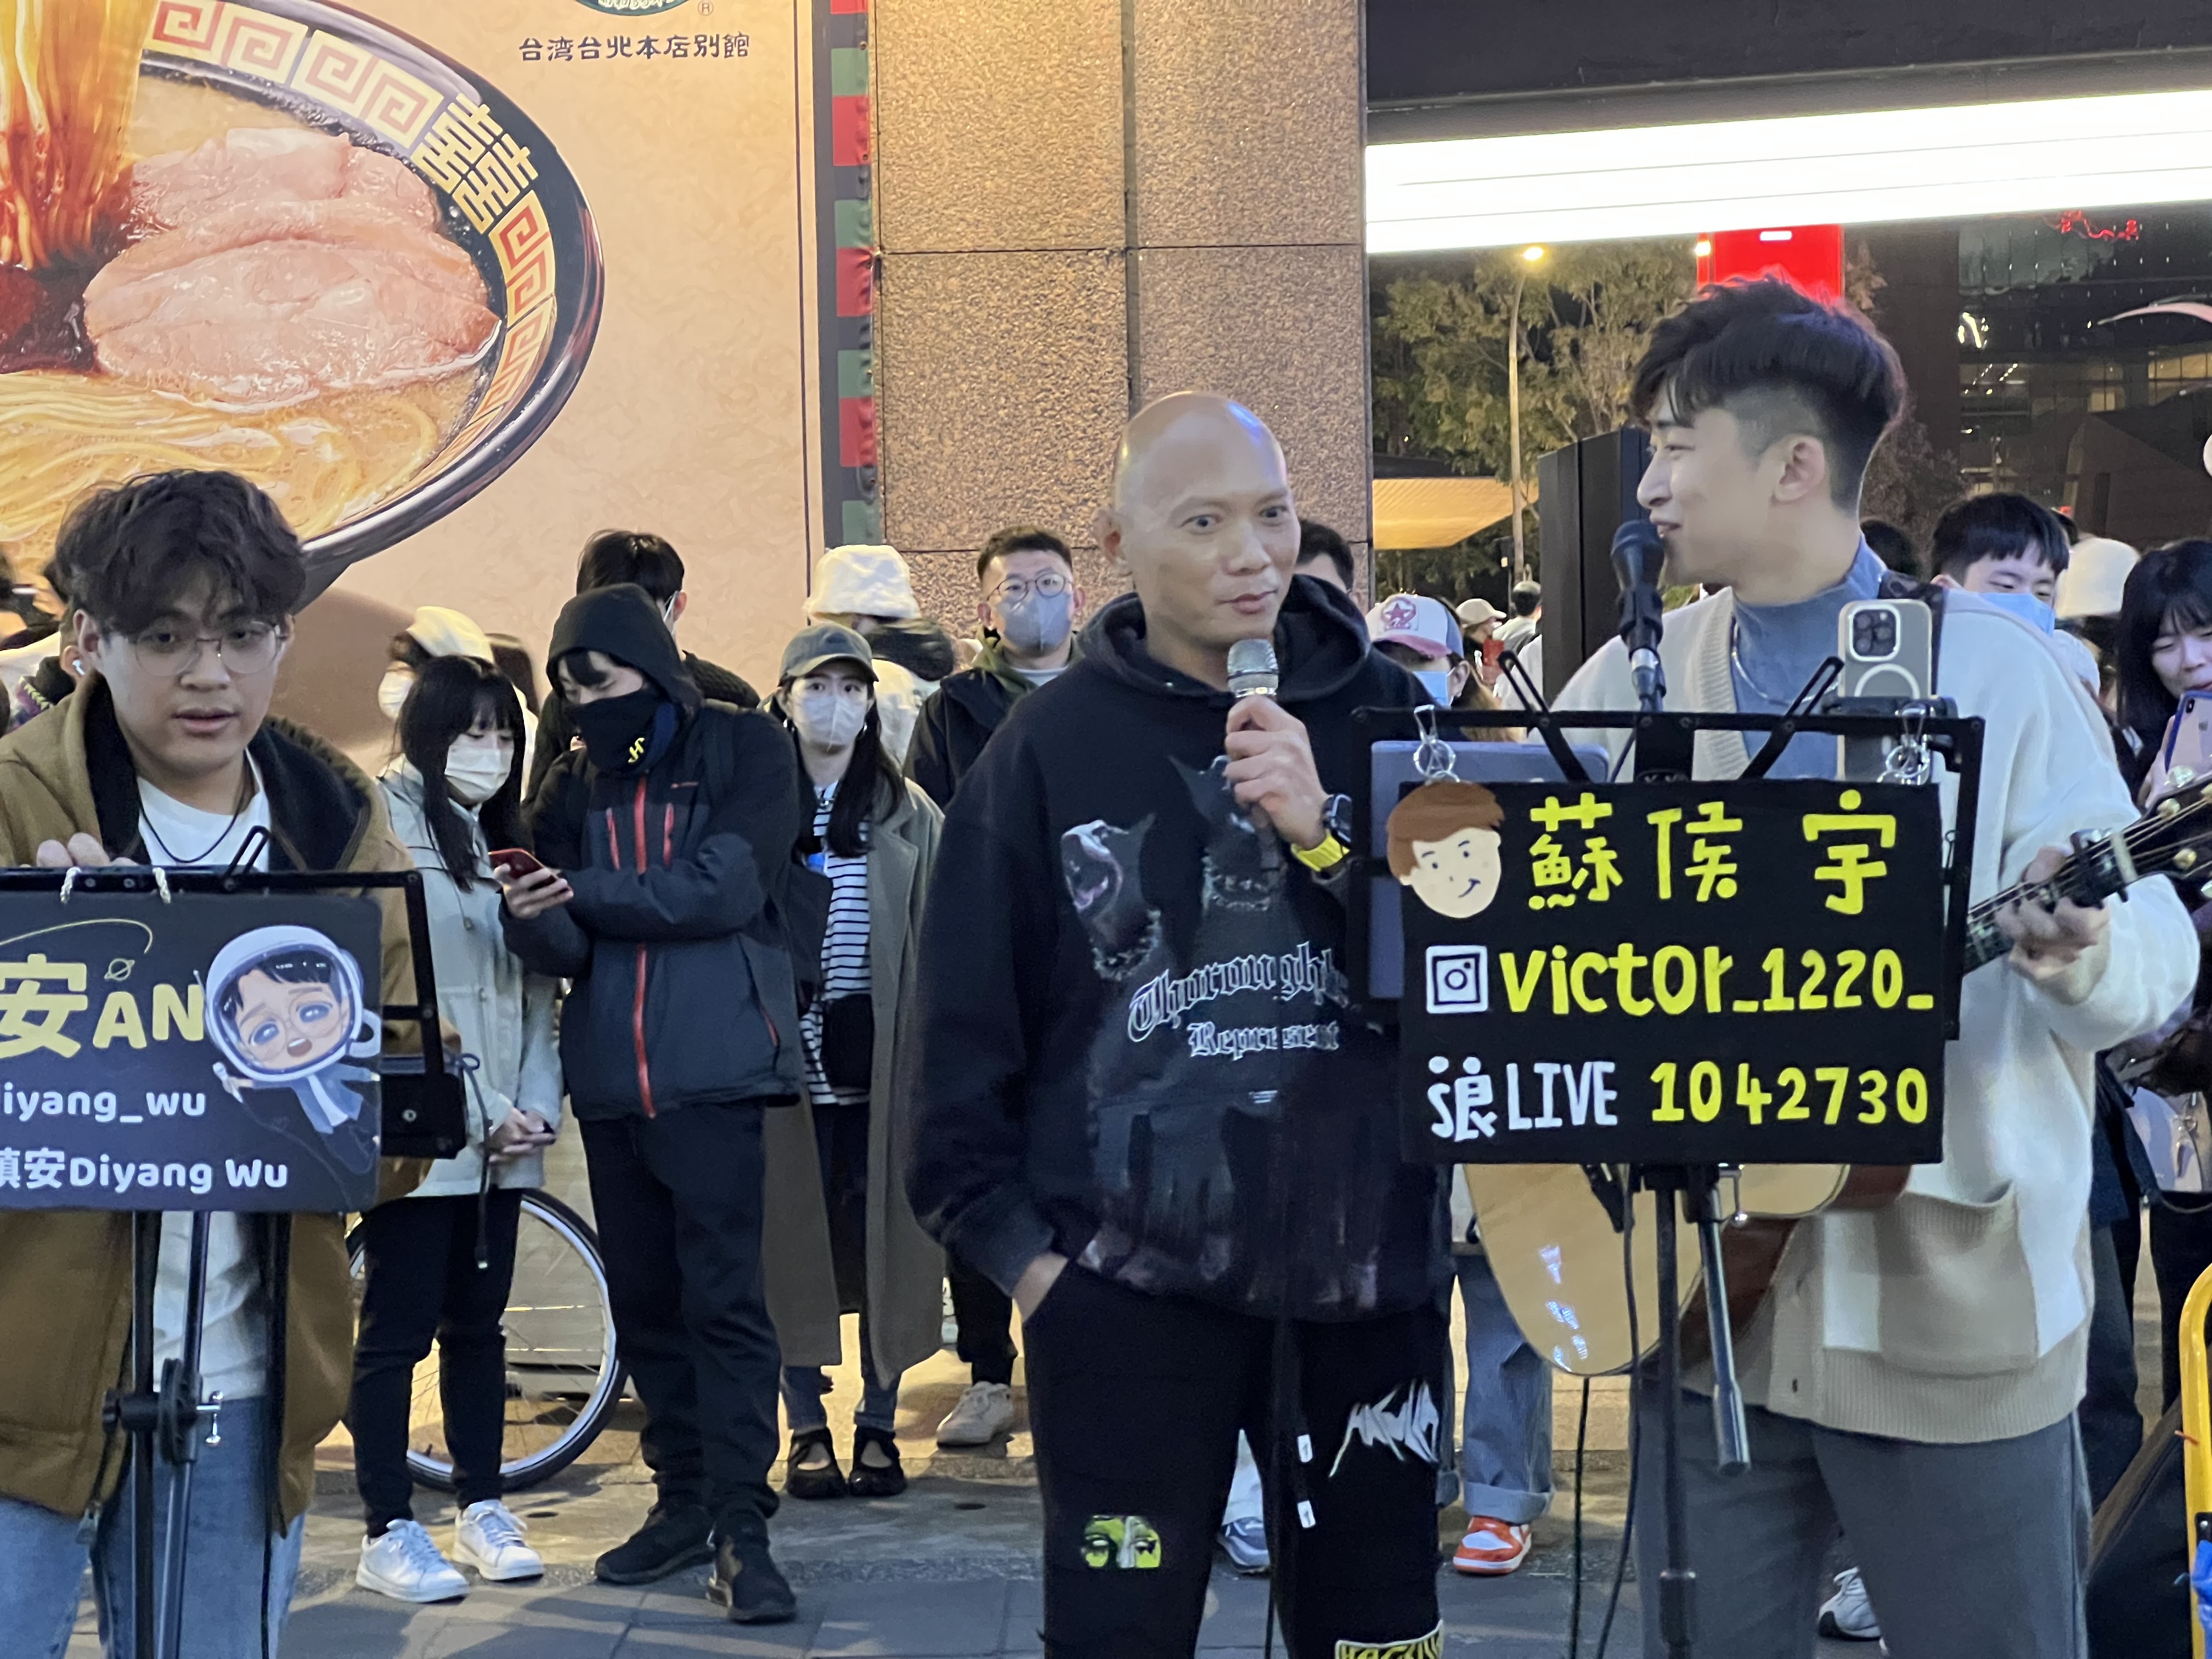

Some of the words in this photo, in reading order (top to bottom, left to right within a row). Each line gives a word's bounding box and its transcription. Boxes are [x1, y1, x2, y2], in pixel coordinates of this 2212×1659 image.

[518, 32, 750, 61] 台湾台北本店別館
[1650, 1061, 1928, 1125] 1042730
[225, 1159, 287, 1188] Wu
